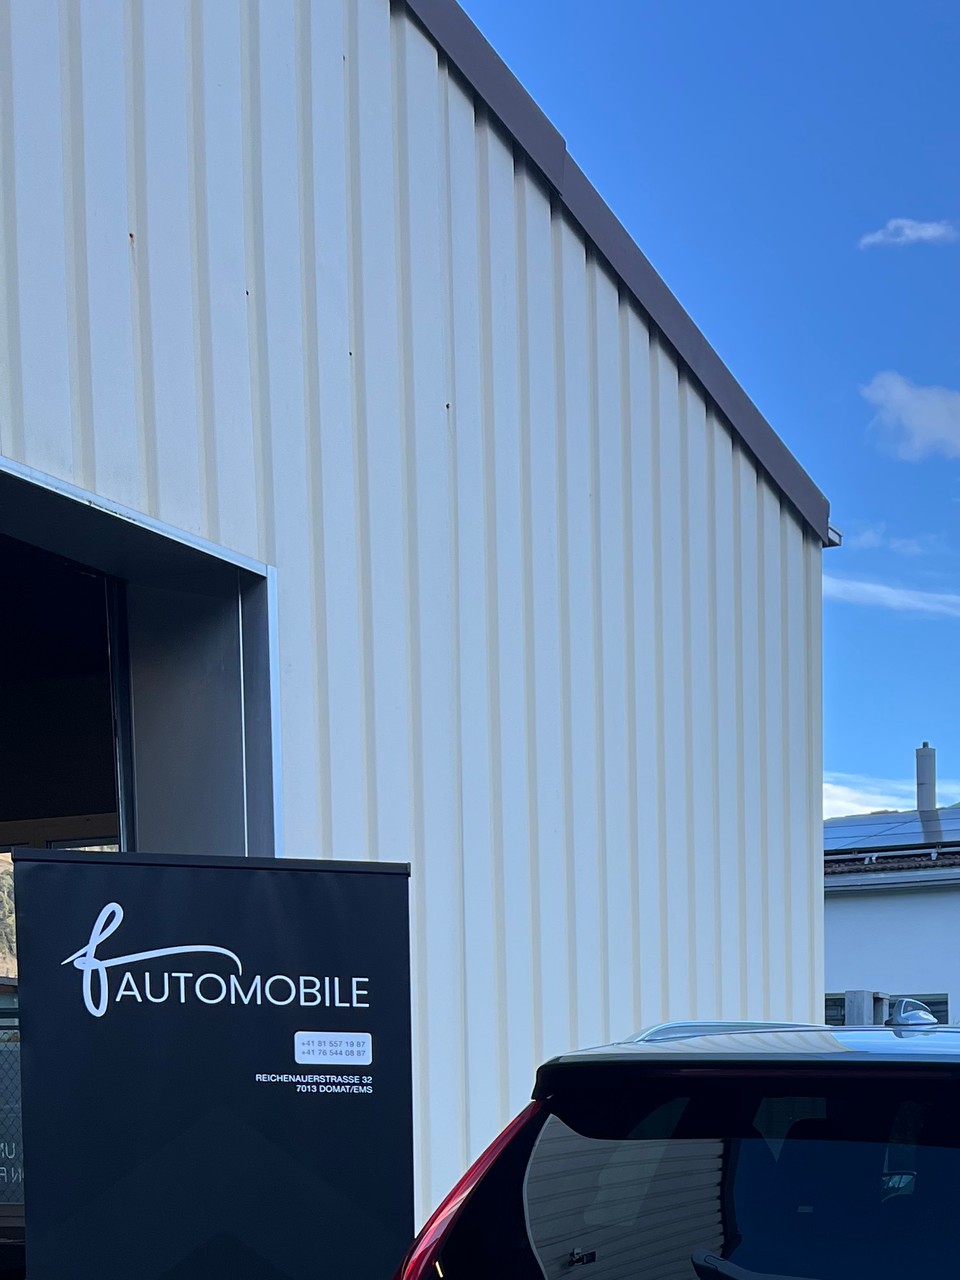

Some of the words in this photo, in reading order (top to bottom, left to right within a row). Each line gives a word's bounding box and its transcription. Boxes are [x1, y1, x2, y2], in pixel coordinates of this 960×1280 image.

[301, 1040, 315, 1048] +41
[317, 1040, 327, 1048] 81
[328, 1040, 343, 1048] 557
[301, 1049, 315, 1057] +41
[317, 1049, 328, 1057] 76
[329, 1049, 343, 1057] 544
[255, 1073, 360, 1083] REICHENAUERSTRASSE
[361, 1075, 373, 1084] 32
[295, 1084, 317, 1093] 7013
[319, 1084, 373, 1094] DOMAT/EMS
